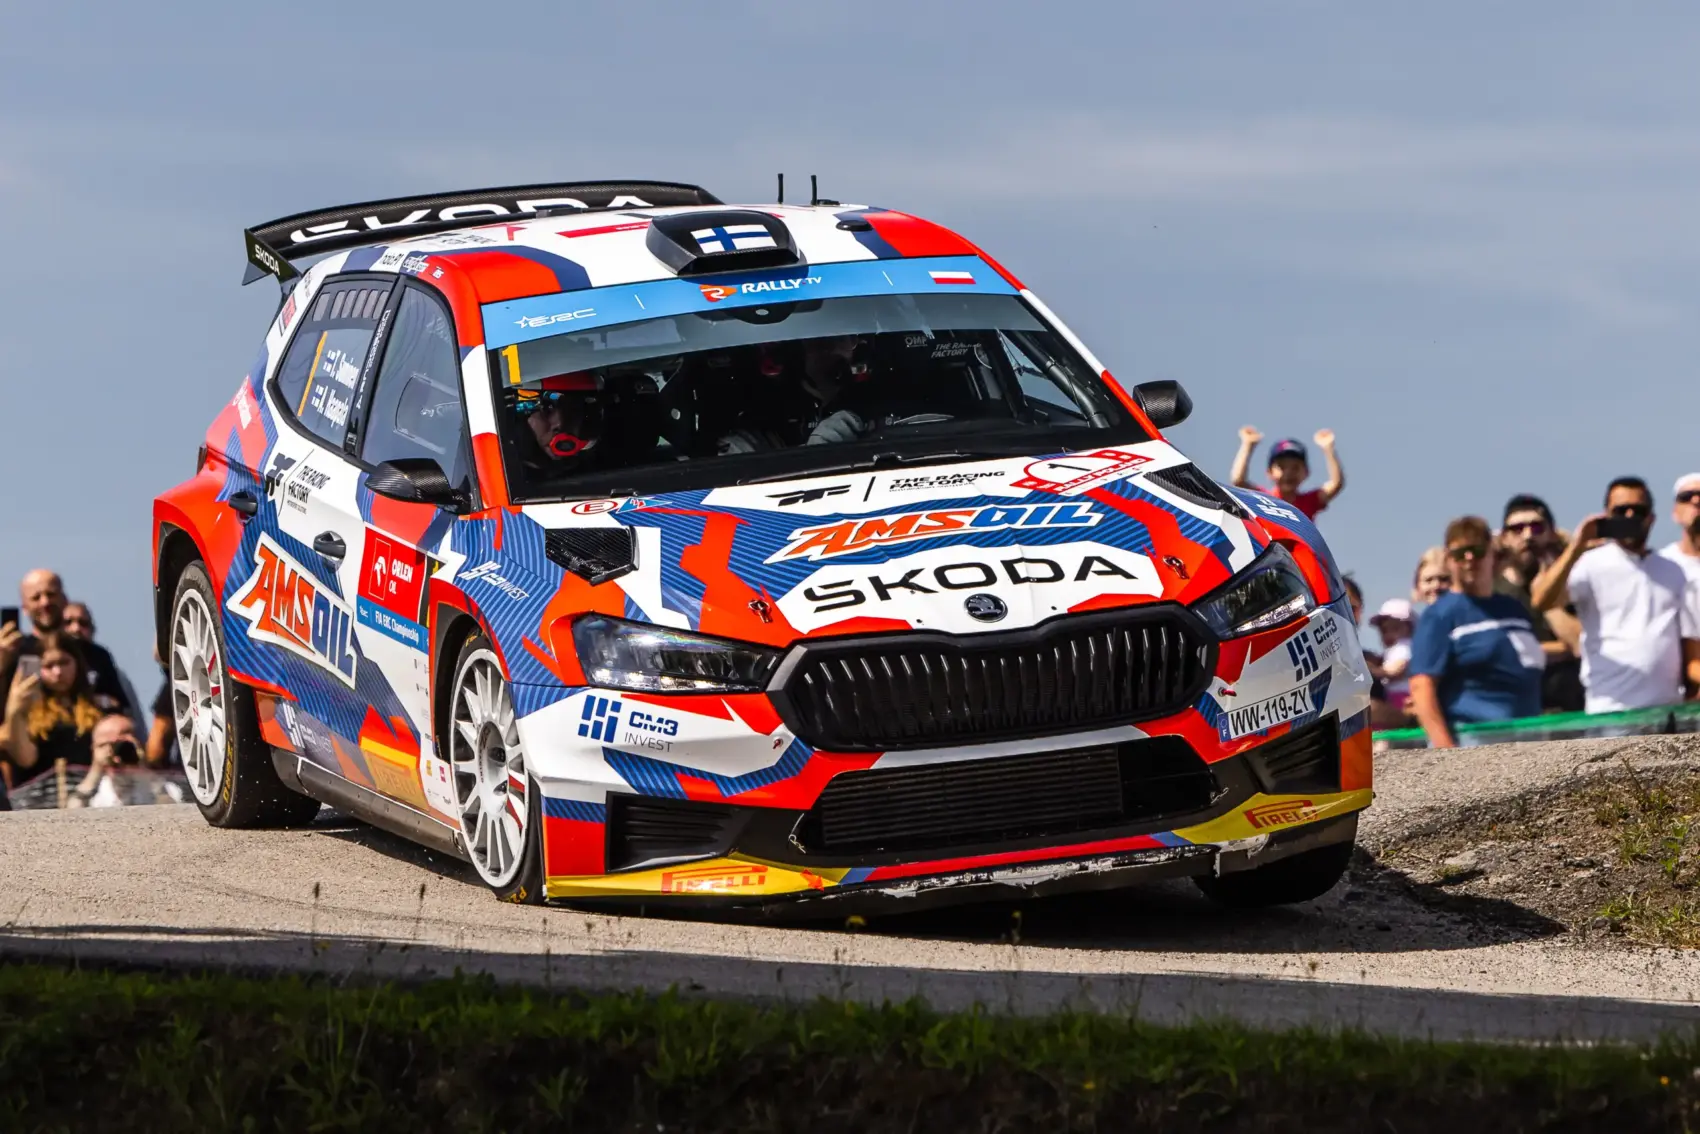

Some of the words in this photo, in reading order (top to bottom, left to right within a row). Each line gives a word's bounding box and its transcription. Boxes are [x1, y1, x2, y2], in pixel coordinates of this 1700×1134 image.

[254, 243, 281, 276] SKODA
[930, 348, 968, 358] FACTORY
[935, 342, 951, 350] THE
[502, 344, 522, 385] 1
[893, 476, 931, 484] THE
[936, 471, 1005, 480] RACING
[1047, 463, 1092, 472] 1
[288, 480, 312, 504] FACTORY
[889, 478, 977, 489] FACTORY
[784, 502, 1095, 560] AMSOIL
[391, 558, 414, 583] ORLEN
[388, 579, 397, 595] OIL
[803, 555, 1139, 613] SKODA
[240, 545, 355, 682] AMSOIL
[375, 610, 383, 625] FIA
[1319, 636, 1344, 661] INVEST
[628, 710, 679, 736] CM3
[1230, 686, 1310, 736] WW-119-ZY
[624, 732, 674, 752] INVEST
[660, 864, 769, 895] PIRELLI
